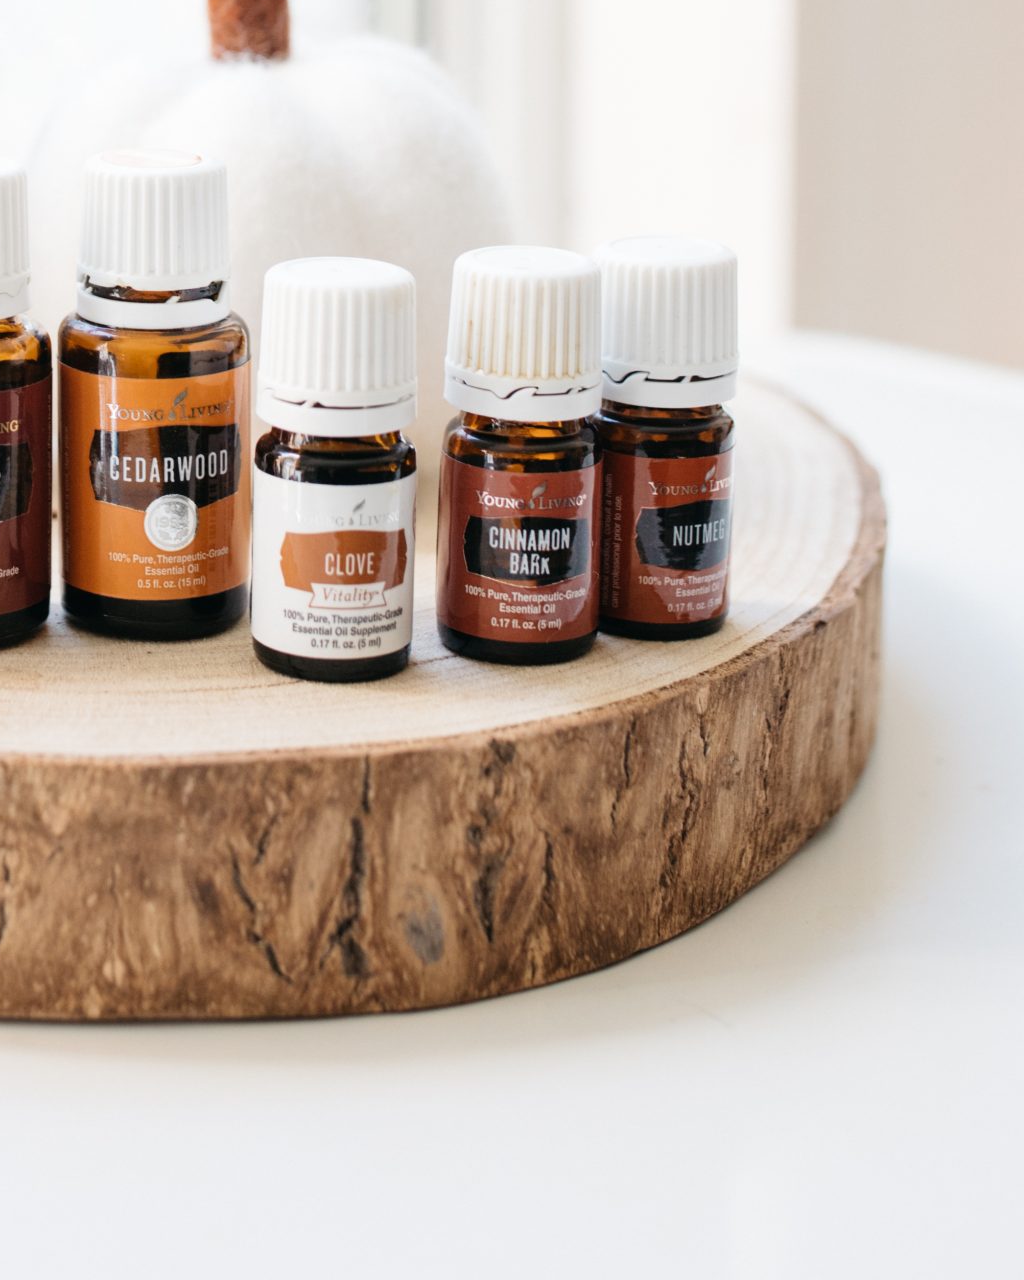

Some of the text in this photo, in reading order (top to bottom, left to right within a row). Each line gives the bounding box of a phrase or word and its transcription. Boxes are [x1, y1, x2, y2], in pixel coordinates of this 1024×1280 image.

[106, 403, 164, 421] YOUNG
[109, 449, 229, 483] CEDARWOOD
[648, 481, 699, 496] YOUNG
[476, 490, 525, 510] YOUNG
[614, 513, 622, 521] to
[489, 525, 571, 552] CINNAMON
[613, 523, 622, 542] prior
[673, 519, 725, 546] NUTMEG
[108, 546, 229, 565] 100% Pure, Therapeutic-Grade
[144, 564, 200, 576] Essential Oil
[324, 552, 375, 576] CLOVE
[611, 543, 621, 589] professional
[137, 576, 206, 590] 0.5 fl. oz. (15 ml)
[638, 575, 662, 586] 100%
[664, 577, 687, 587] Pure,
[464, 584, 587, 603] 100% Pure, Therapeutic-Grade
[676, 584, 711, 598] Essential
[499, 603, 556, 615] Essential Oil
[667, 602, 686, 613] 0.17
[687, 601, 695, 611] fl.
[283, 606, 403, 625] 100% Pure, Therapeutic-Grade
[292, 622, 397, 637] Essential Oil Supplement
[491, 617, 562, 631] 0.17 fl. oz. (5 ml)
[311, 636, 381, 650] 0.17 fl. oz. (5 ml)
